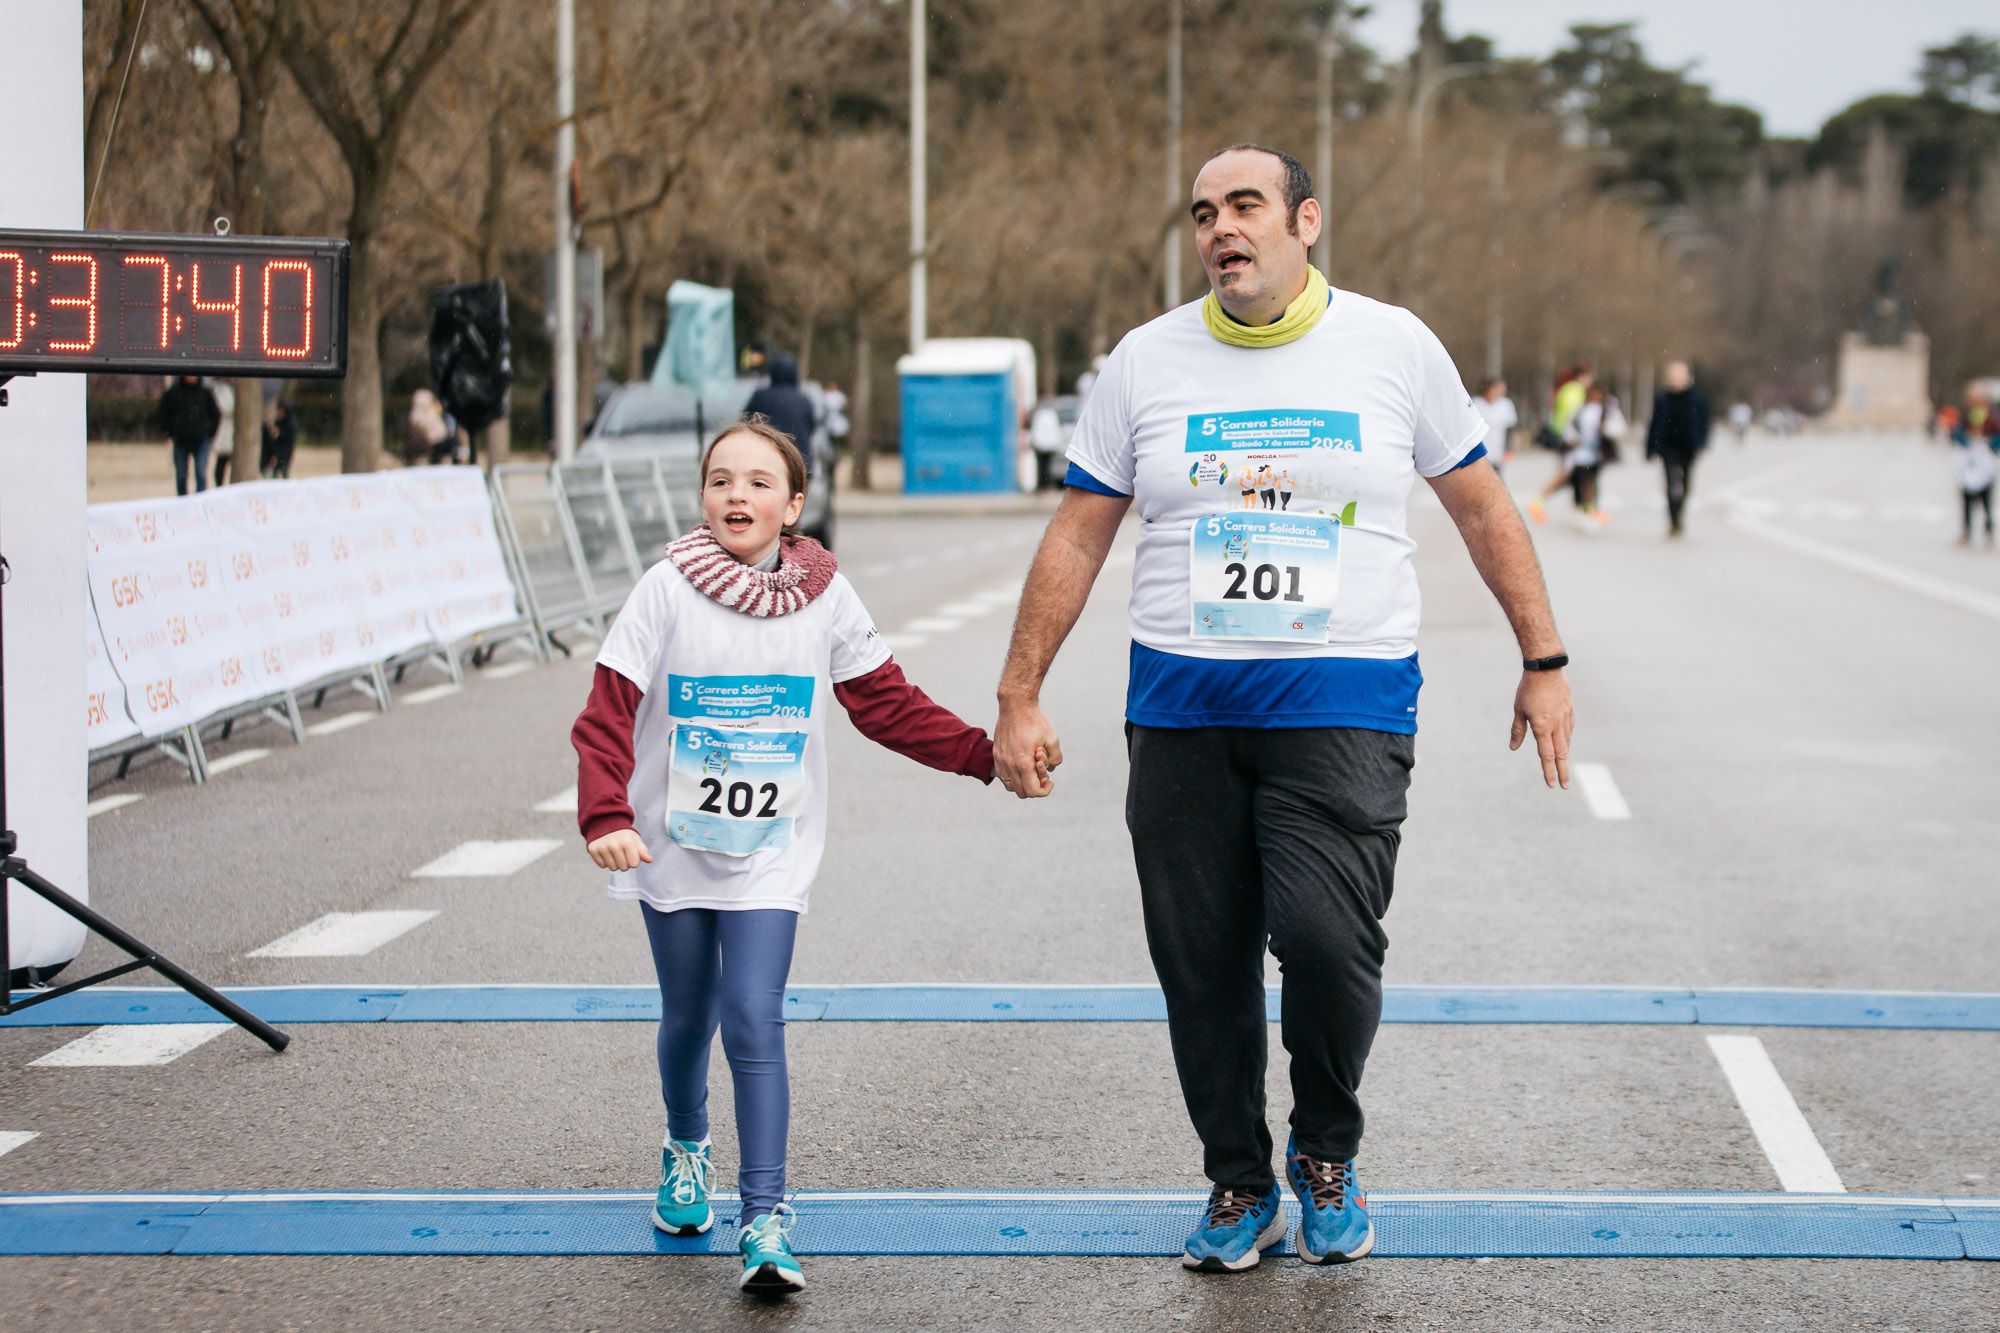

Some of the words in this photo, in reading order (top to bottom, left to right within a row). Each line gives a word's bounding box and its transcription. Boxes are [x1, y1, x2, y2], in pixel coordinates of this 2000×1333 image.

[1220, 419, 1267, 430] Carrera
[1270, 417, 1325, 428] Solidaria
[1232, 439, 1262, 448] Sábado
[1271, 439, 1281, 447] de
[1311, 436, 1356, 451] 2026
[1224, 521, 1266, 533] Carrera
[1269, 523, 1317, 537] Solidaria
[112, 574, 144, 608] GSK
[1223, 562, 1304, 602] 201
[220, 656, 244, 686] GSK
[146, 677, 180, 712] GSK
[696, 685, 738, 695] Carrera
[741, 684, 787, 694] Solidaria
[87, 692, 109, 726] SK
[772, 704, 805, 718] 2026
[704, 737, 744, 750] Carrera
[747, 741, 787, 751] Solidaria
[699, 777, 778, 818] 202
